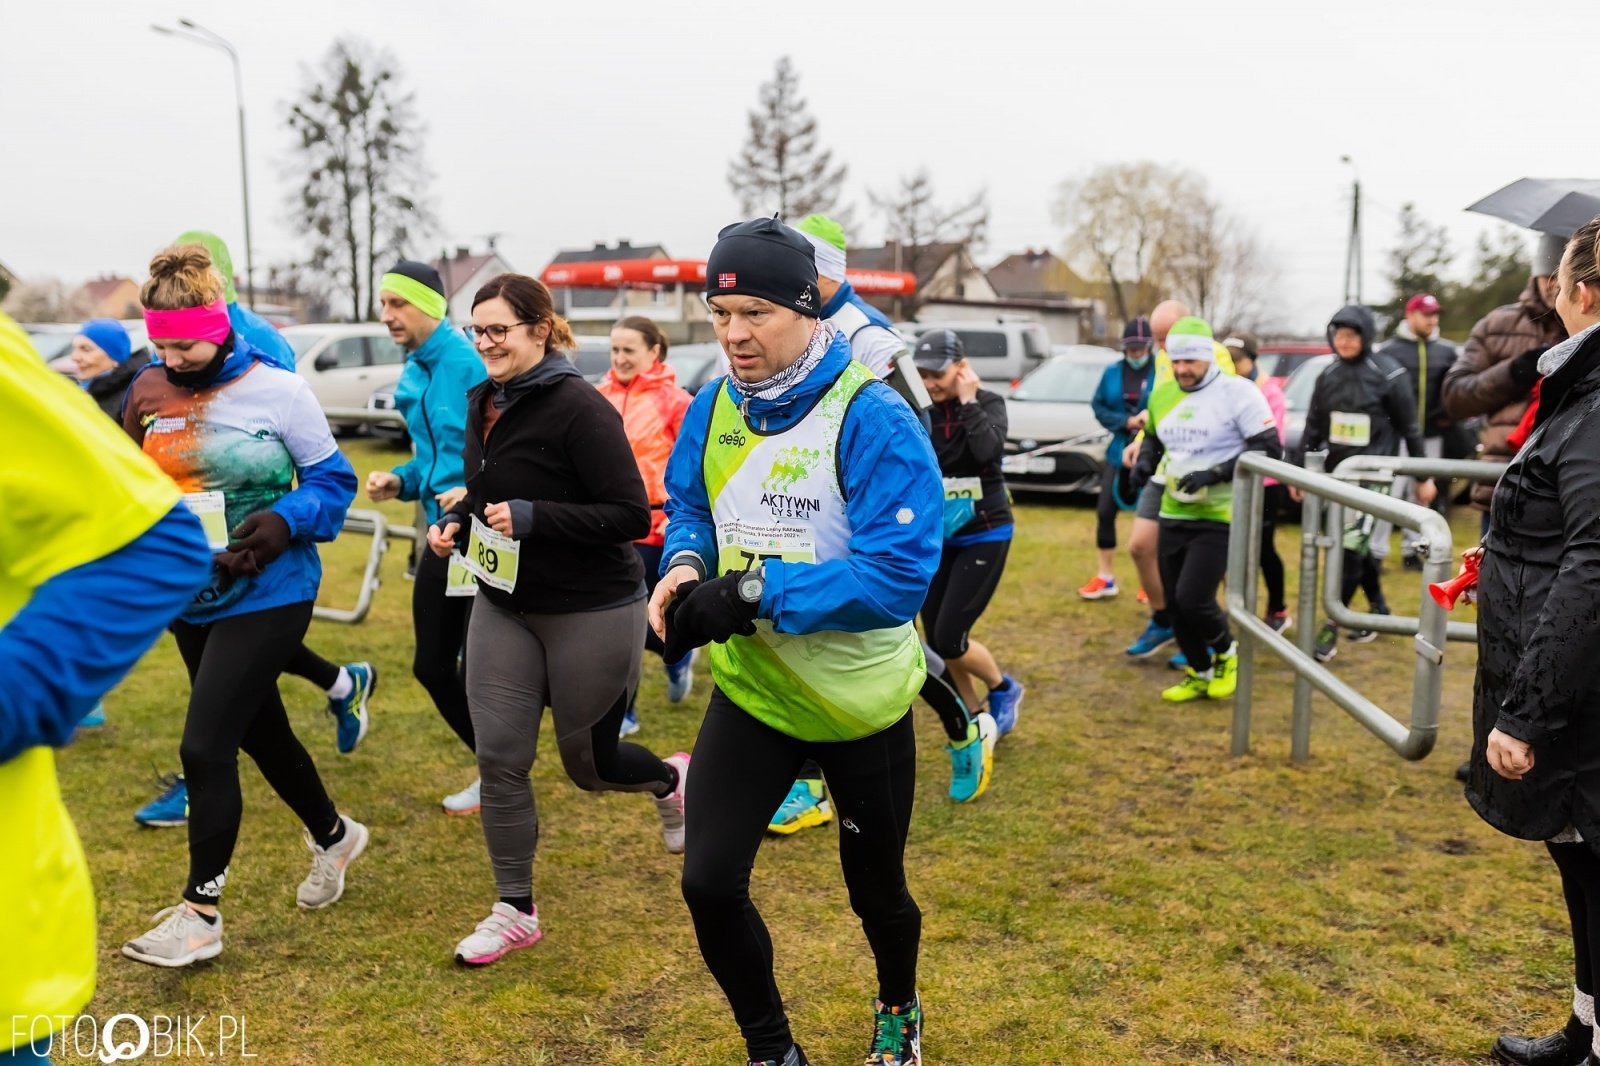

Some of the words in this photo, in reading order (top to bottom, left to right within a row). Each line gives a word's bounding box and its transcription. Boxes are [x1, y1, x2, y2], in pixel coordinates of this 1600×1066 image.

[760, 493, 820, 512] AKTYWNI
[771, 507, 810, 519] LYSKI
[479, 541, 499, 574] 89
[740, 550, 782, 571] 7
